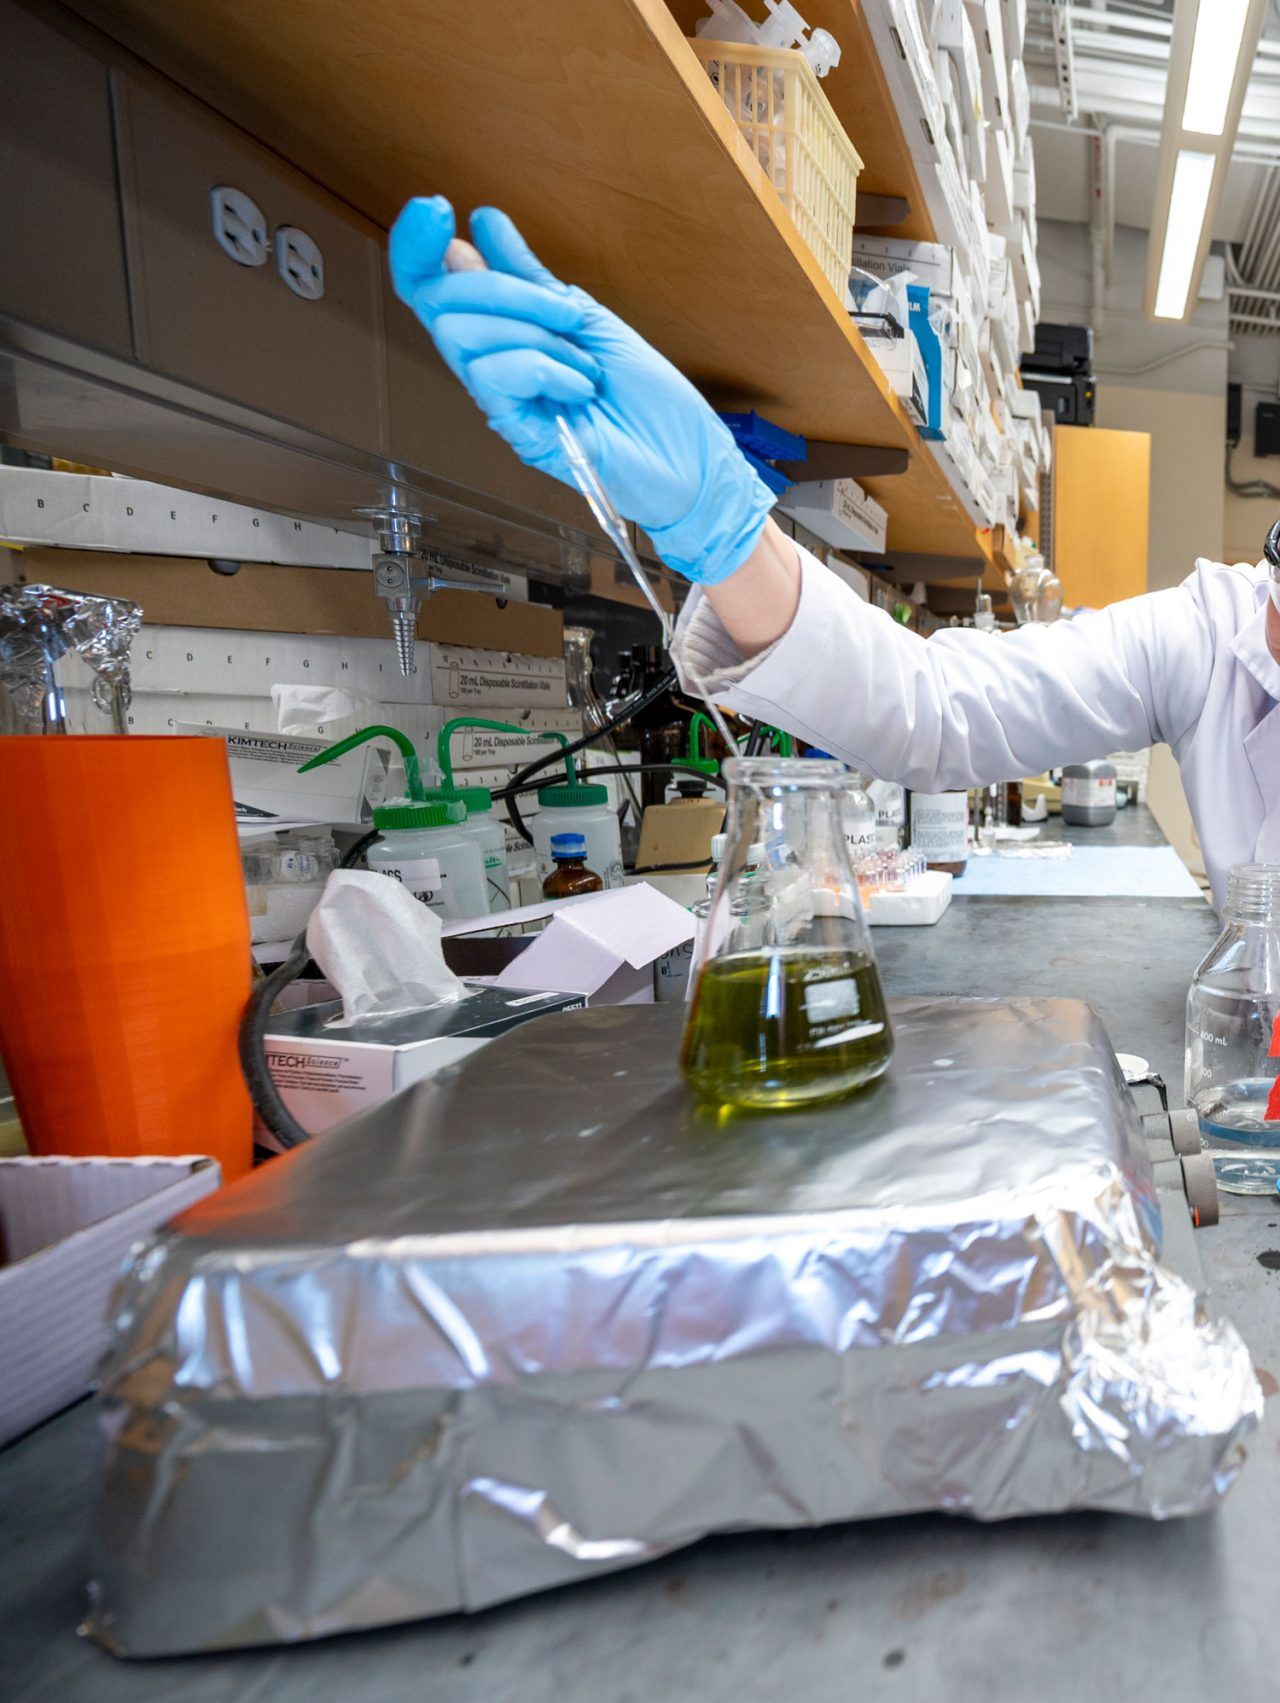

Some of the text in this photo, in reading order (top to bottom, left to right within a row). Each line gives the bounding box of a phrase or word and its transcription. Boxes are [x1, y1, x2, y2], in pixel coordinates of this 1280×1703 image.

[852, 256, 885, 271] illation
[37, 499, 302, 531] B C D E F G H
[146, 651, 153, 660] C
[187, 653, 193, 662] D
[227, 655, 233, 664] E
[266, 658, 271, 666] F
[303, 660, 310, 668] G
[342, 662, 348, 670] H
[460, 675, 469, 686] 20
[469, 675, 479, 686] mL
[480, 677, 511, 689] Disposable
[128, 716, 134, 725] B
[168, 719, 174, 727] C
[317, 726, 324, 734] G
[228, 736, 287, 750] KIMTECH
[474, 737, 482, 748] 20
[482, 737, 493, 748] mL
[494, 737, 525, 749] Disposable
[843, 834, 873, 845] PLAS
[1215, 1037, 1228, 1046] mL
[265, 1053, 305, 1068] TECH
